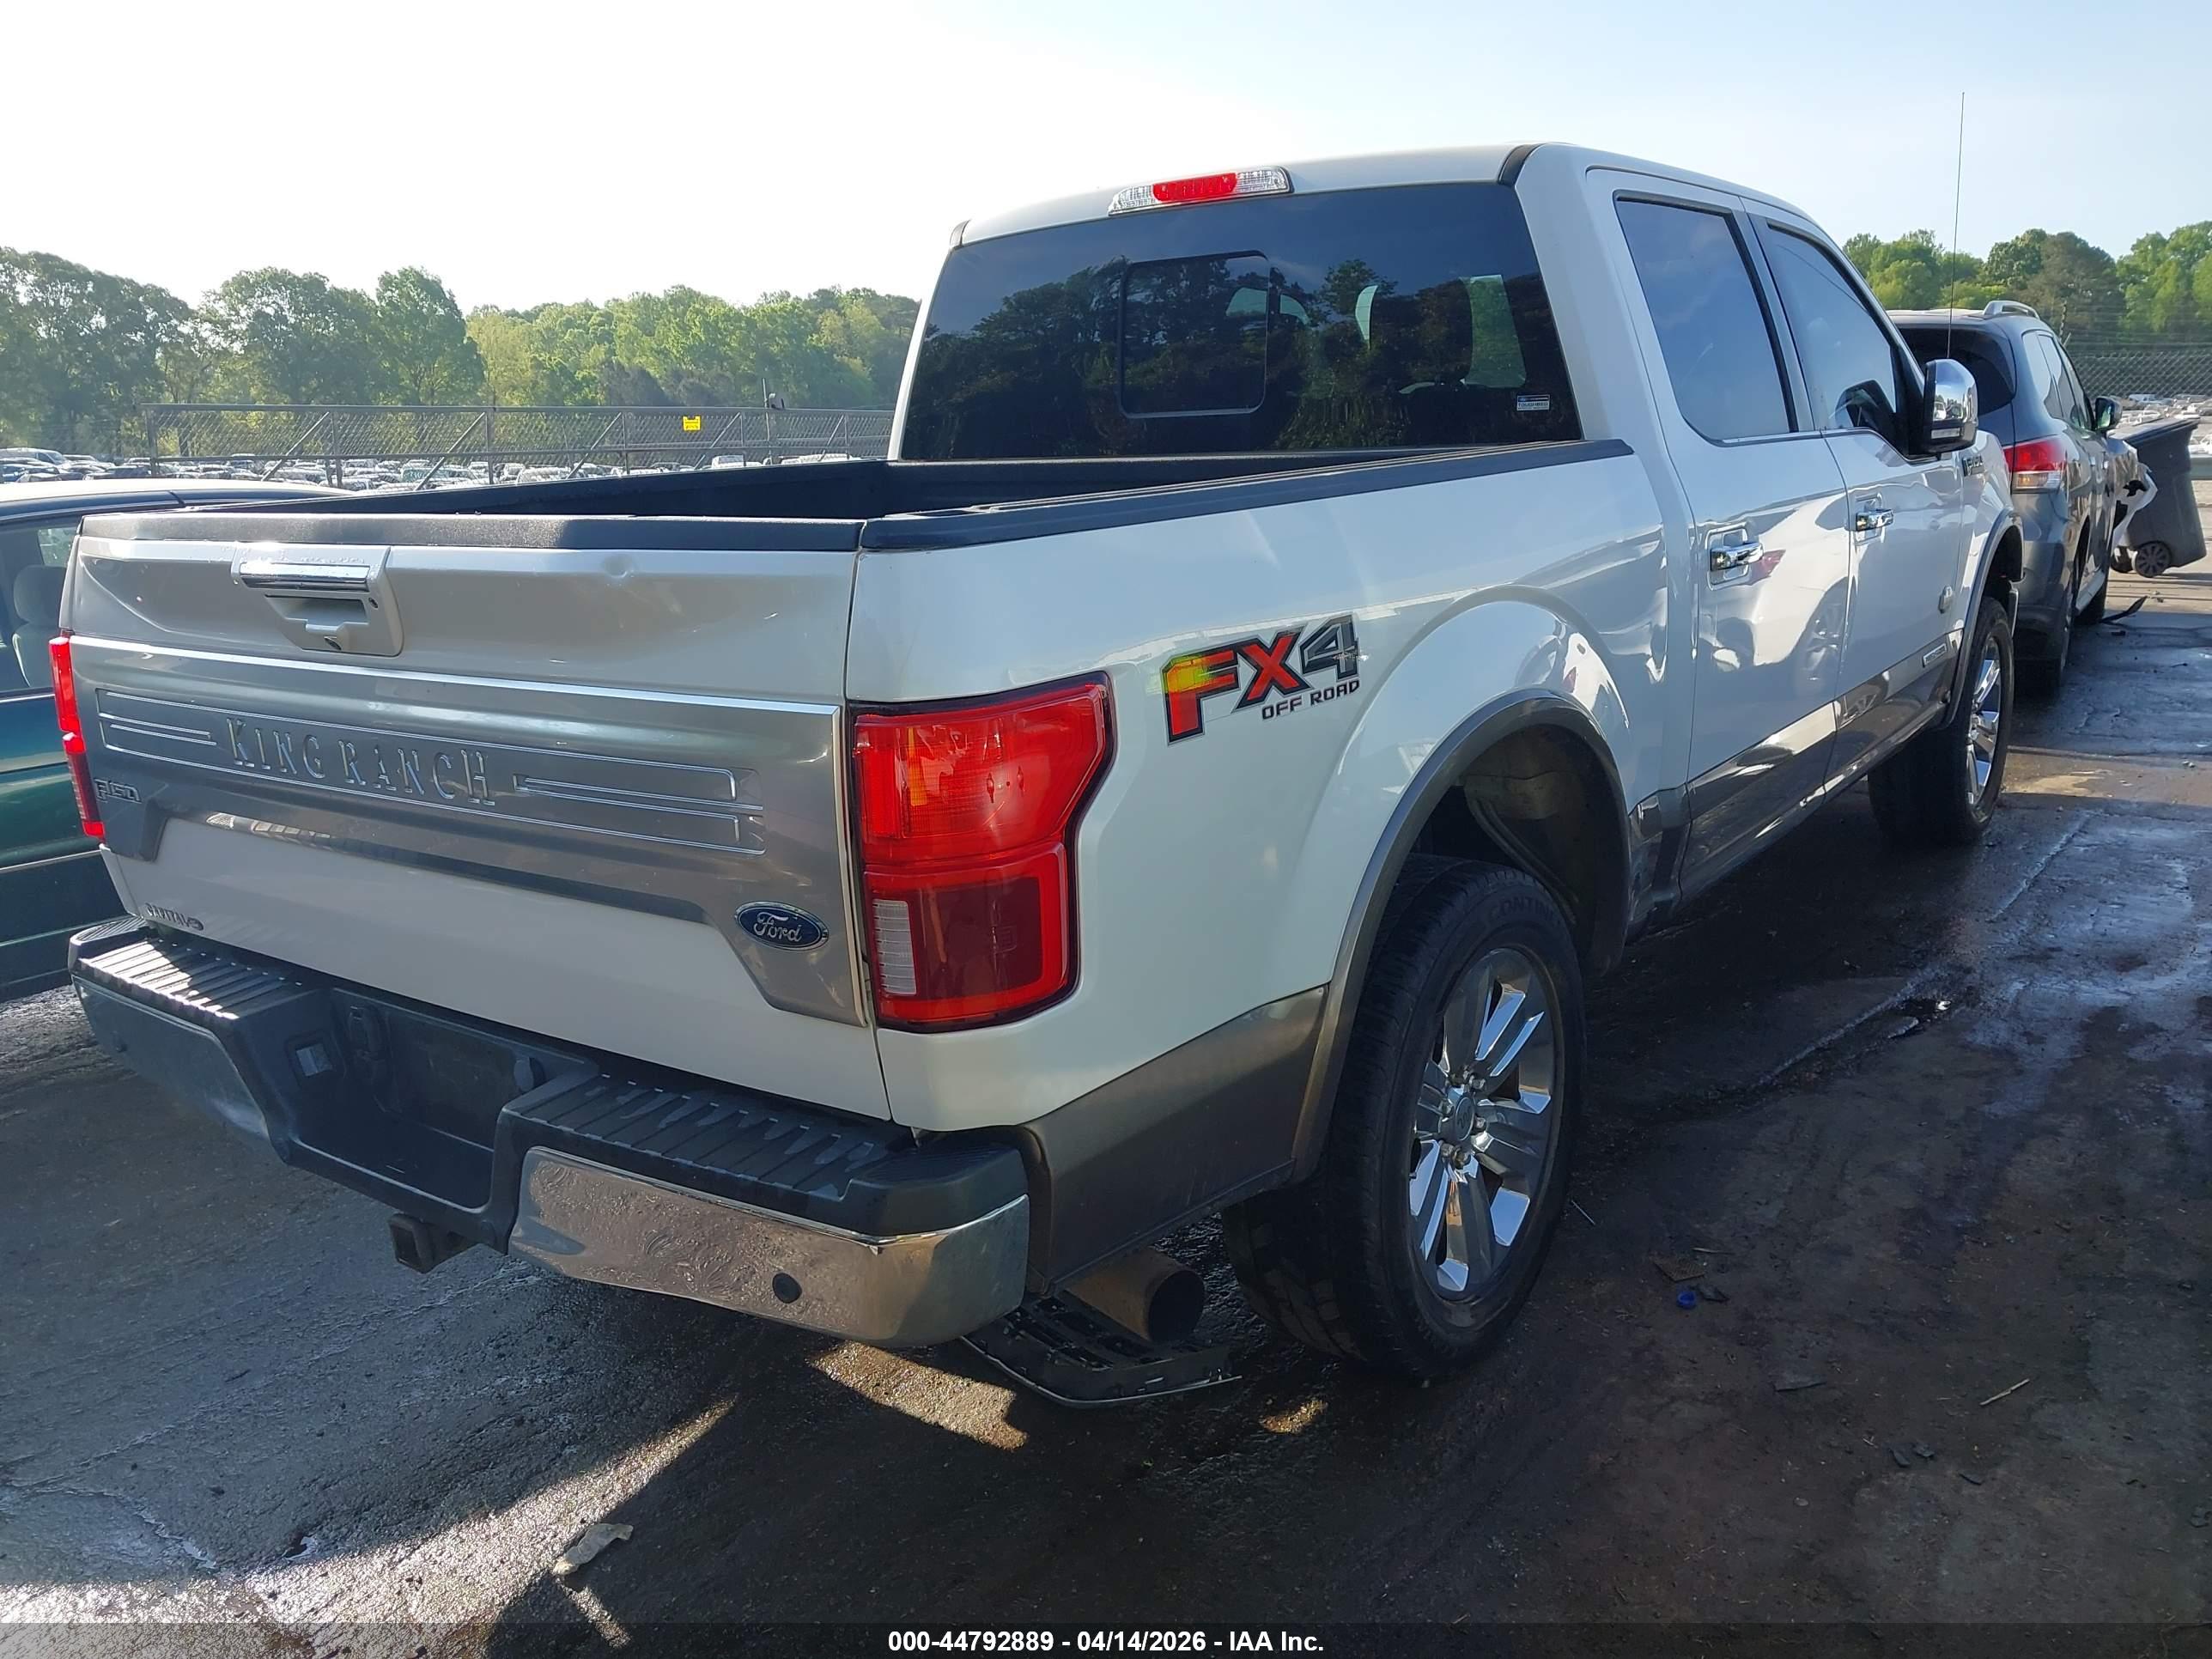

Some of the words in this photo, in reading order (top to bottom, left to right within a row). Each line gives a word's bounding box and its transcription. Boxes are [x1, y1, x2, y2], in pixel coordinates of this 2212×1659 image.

[1162, 613, 1359, 745] FX4
[1261, 697, 1303, 720] OFF
[1310, 679, 1360, 706] ROAD
[226, 717, 326, 780] KING
[337, 739, 496, 805] RANCH
[753, 911, 802, 942] Ford
